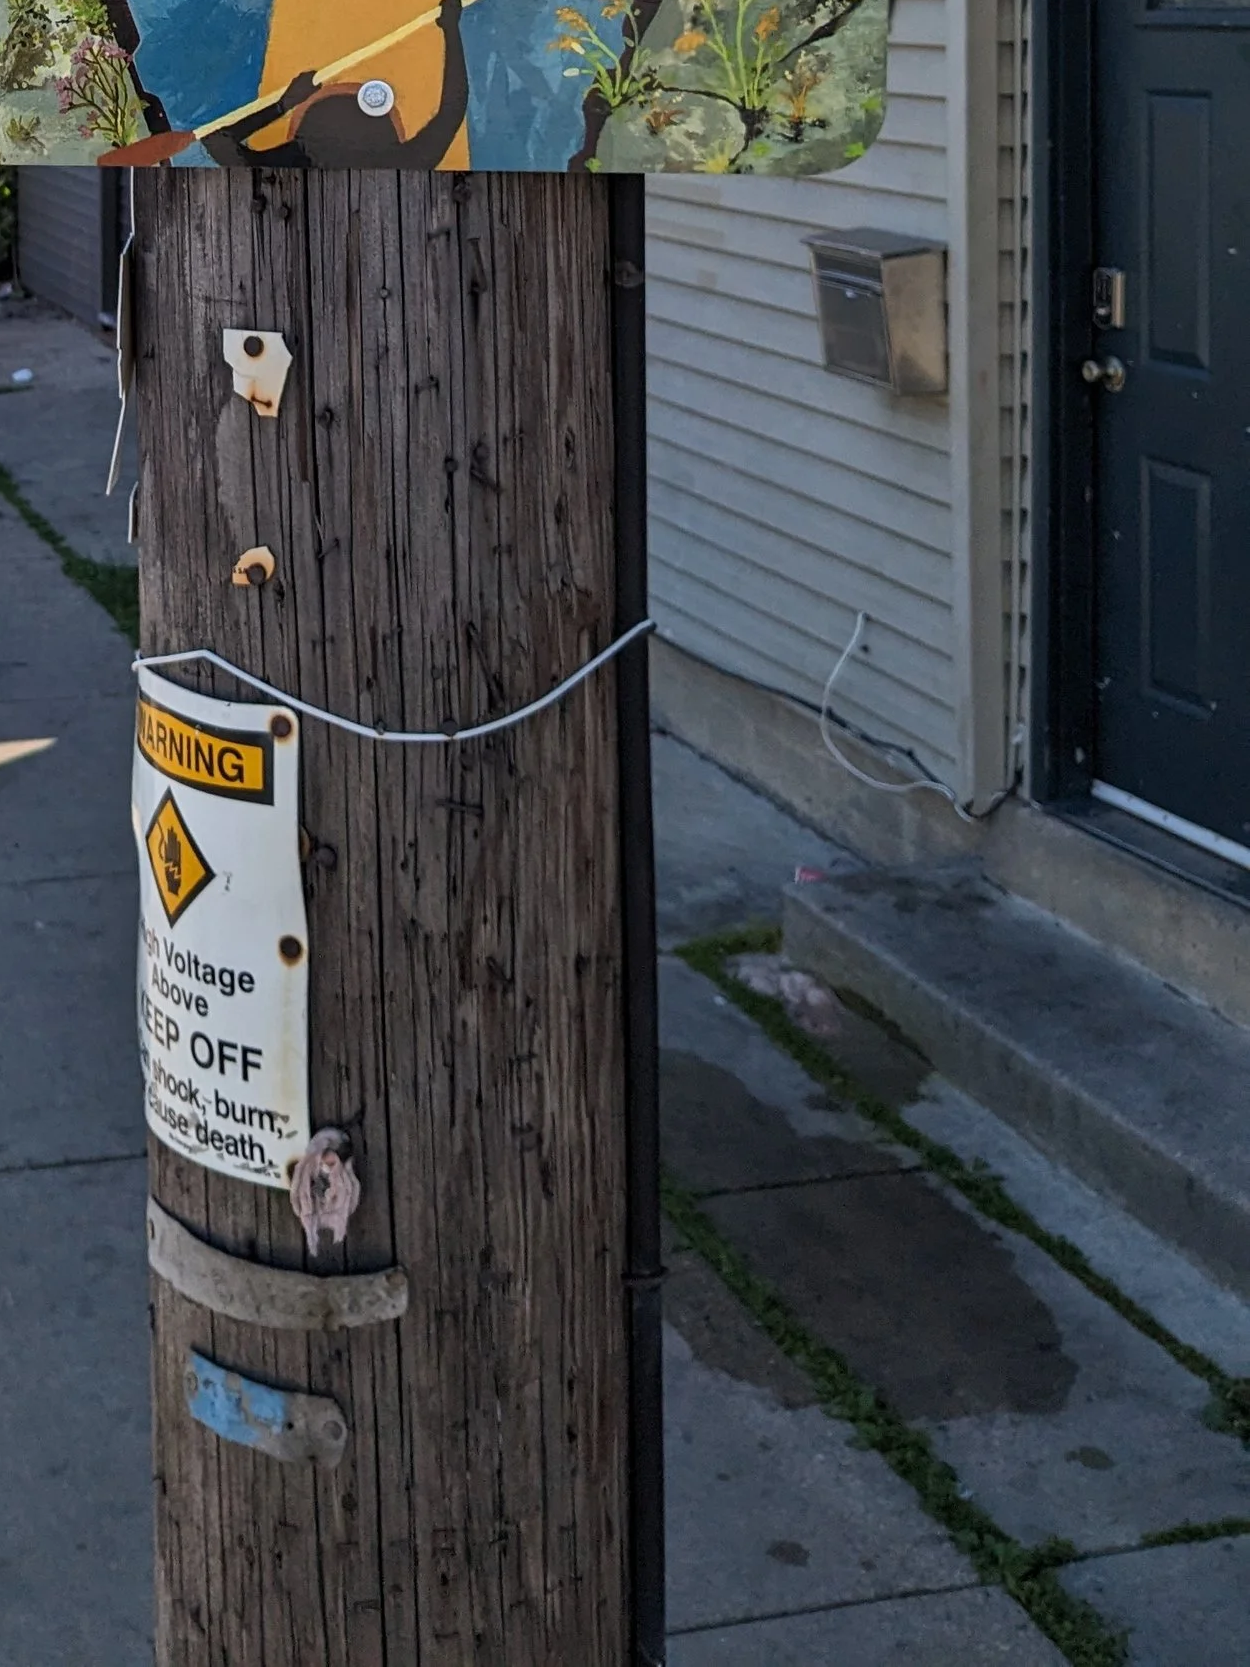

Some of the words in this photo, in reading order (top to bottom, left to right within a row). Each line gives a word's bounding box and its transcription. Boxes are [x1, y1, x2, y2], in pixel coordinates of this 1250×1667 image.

[151, 963, 209, 1017] Above
[163, 937, 255, 996] Voltage
[190, 1031, 262, 1082] OFF
[214, 1088, 283, 1139] burn,
[195, 1119, 275, 1167] death.
